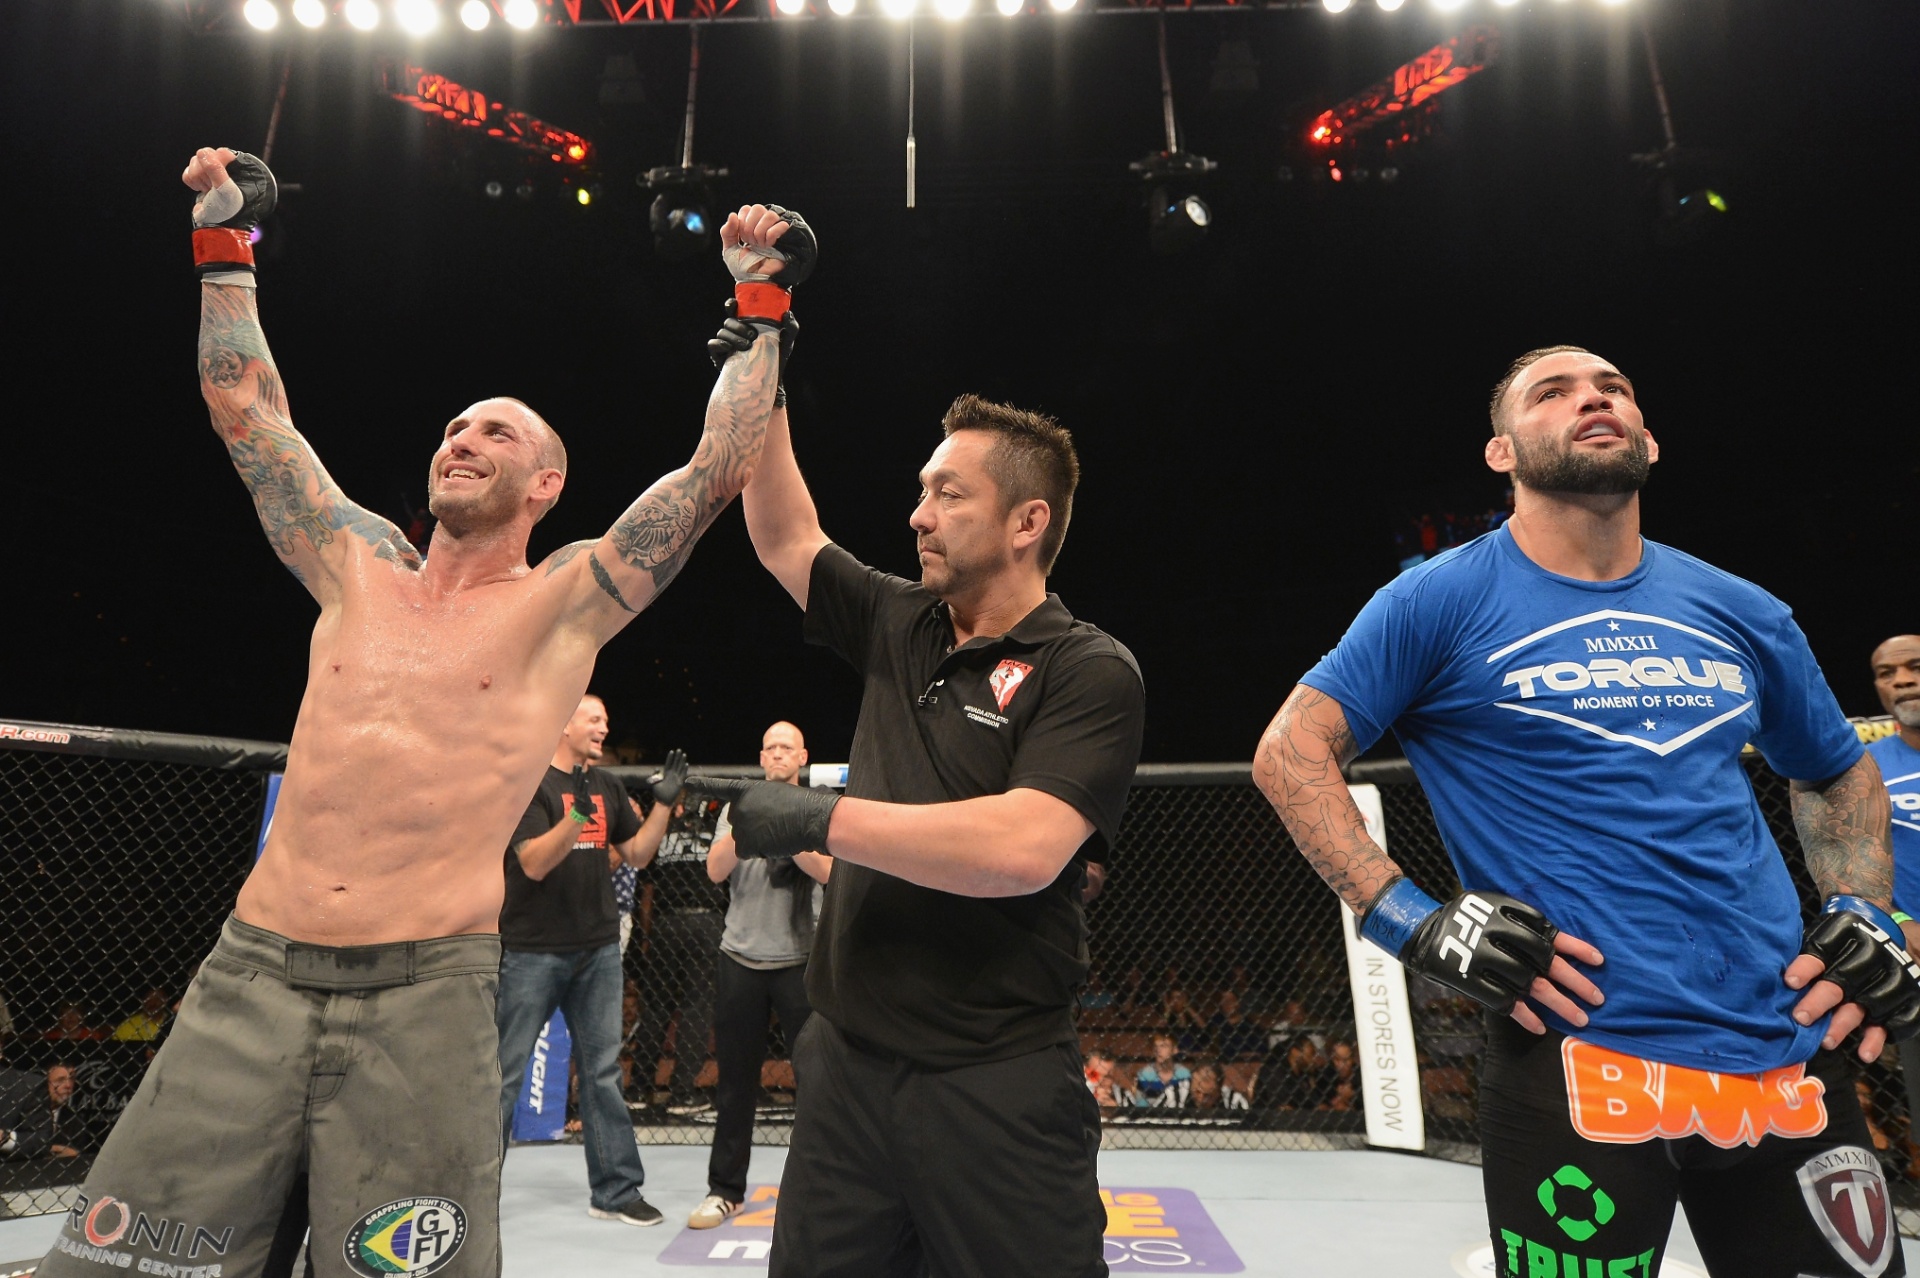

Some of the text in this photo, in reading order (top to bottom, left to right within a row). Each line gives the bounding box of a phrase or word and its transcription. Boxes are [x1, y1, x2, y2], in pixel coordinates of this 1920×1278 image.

[1583, 635, 1659, 653] MMXII
[1502, 657, 1746, 698] TORQUE
[1573, 694, 1715, 710] MOMENT OF FORCE
[967, 712, 1000, 728] COMMISSION
[1439, 894, 1495, 978] UFC
[1365, 957, 1404, 1132] IN STORES NOW
[1814, 1151, 1874, 1172] MMXII
[365, 1199, 457, 1226] GRAPPLING FIGHT TEAM
[67, 1194, 234, 1259] RONIN
[1501, 1228, 1655, 1278] TRUST
[137, 1257, 222, 1278] CENTER
